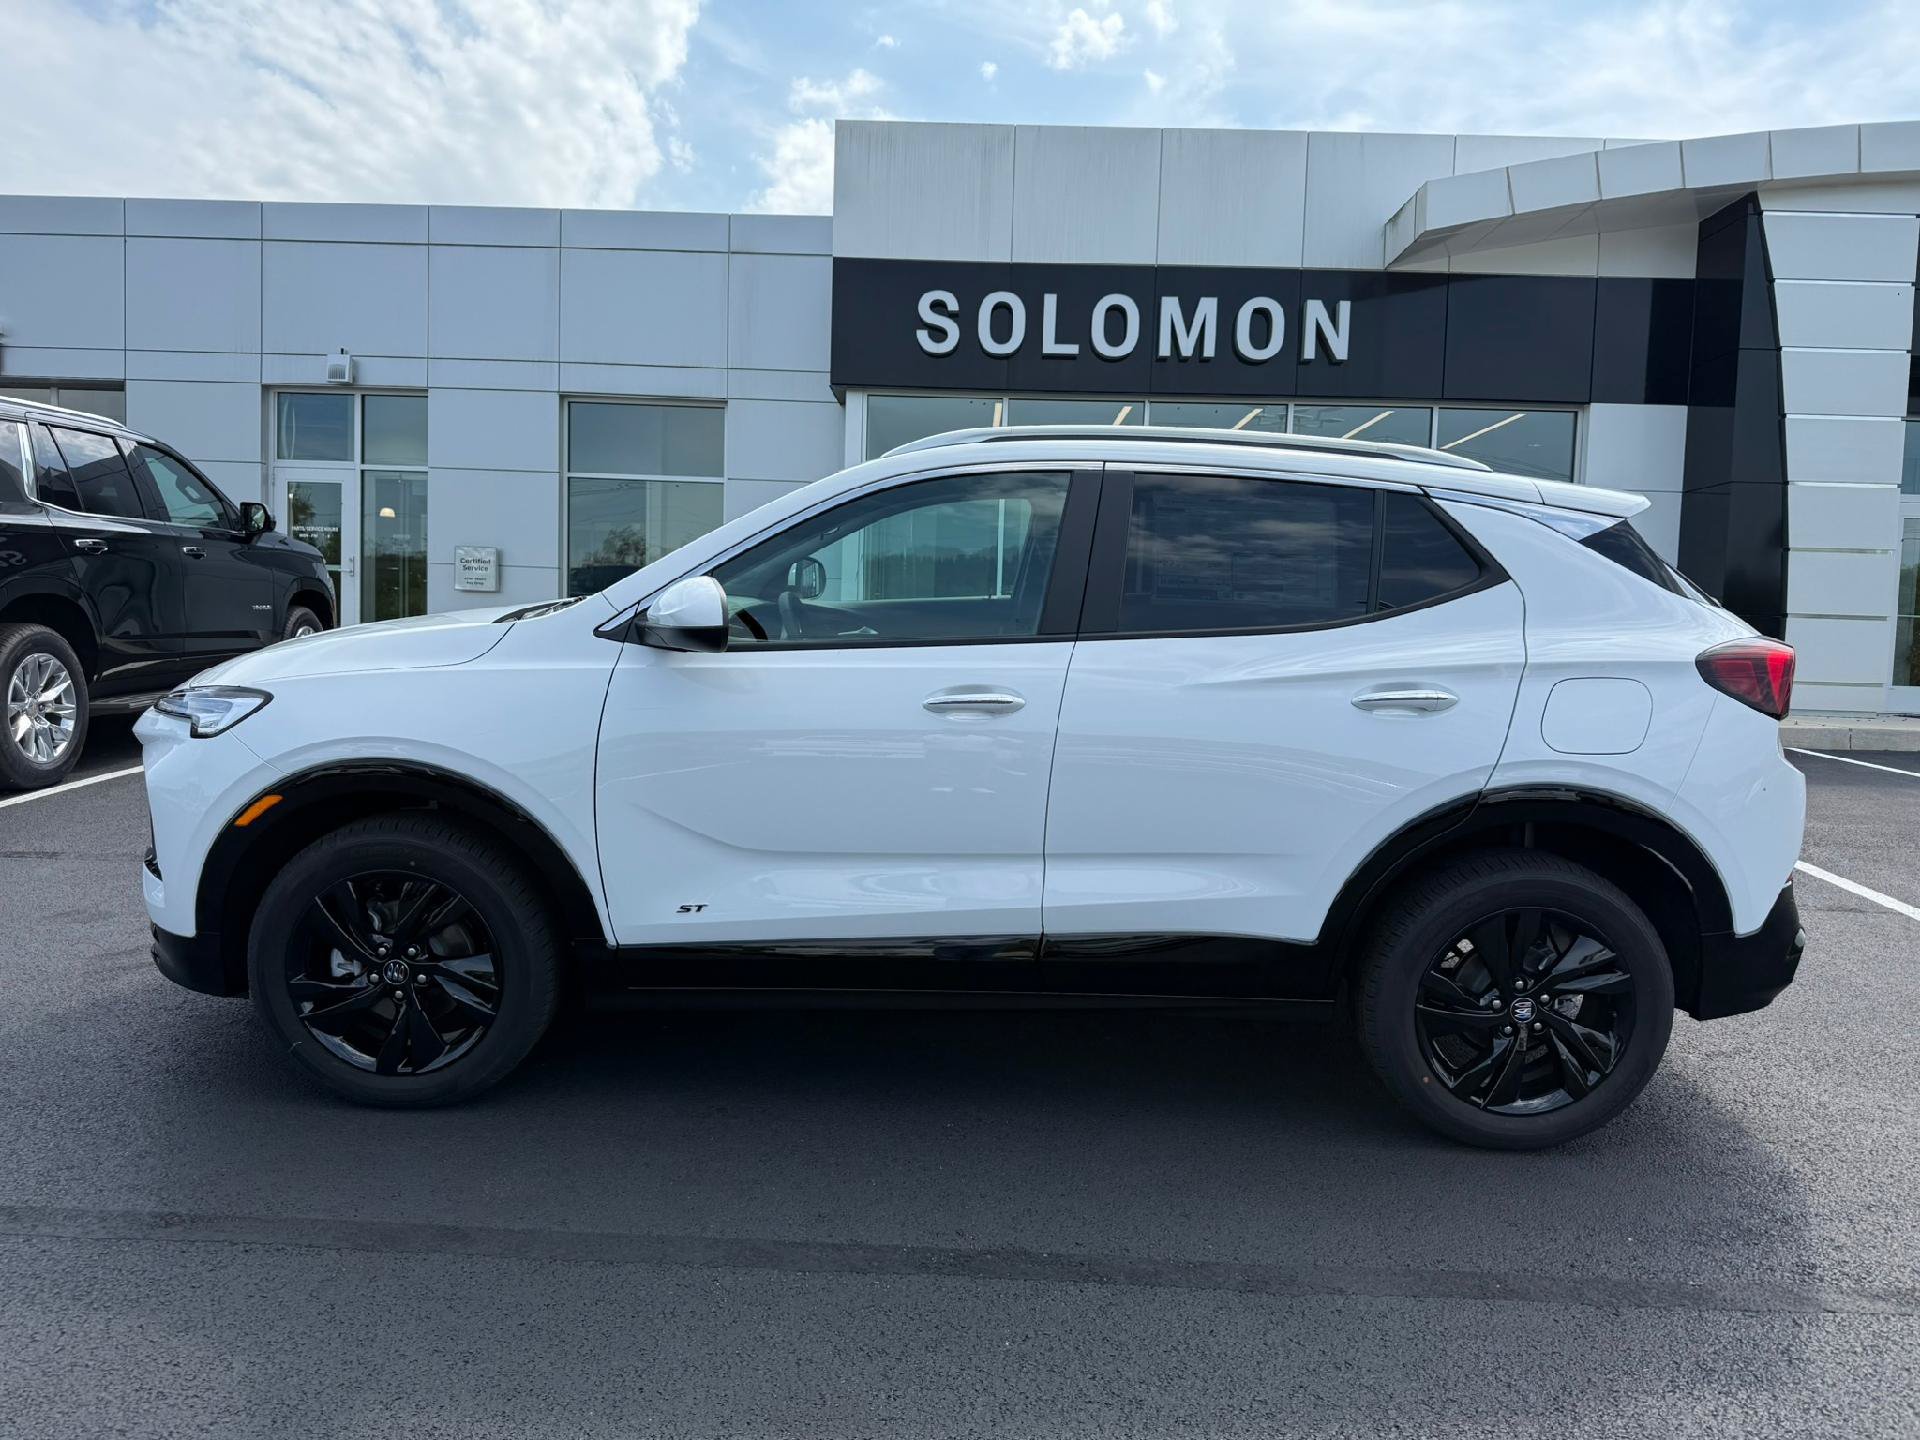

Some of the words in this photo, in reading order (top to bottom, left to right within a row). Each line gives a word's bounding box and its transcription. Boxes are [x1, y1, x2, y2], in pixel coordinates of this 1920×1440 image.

[916, 290, 1352, 363] SOLOMON
[460, 557, 491, 565] Certified
[462, 564, 489, 572] Service
[676, 904, 709, 913] ST
